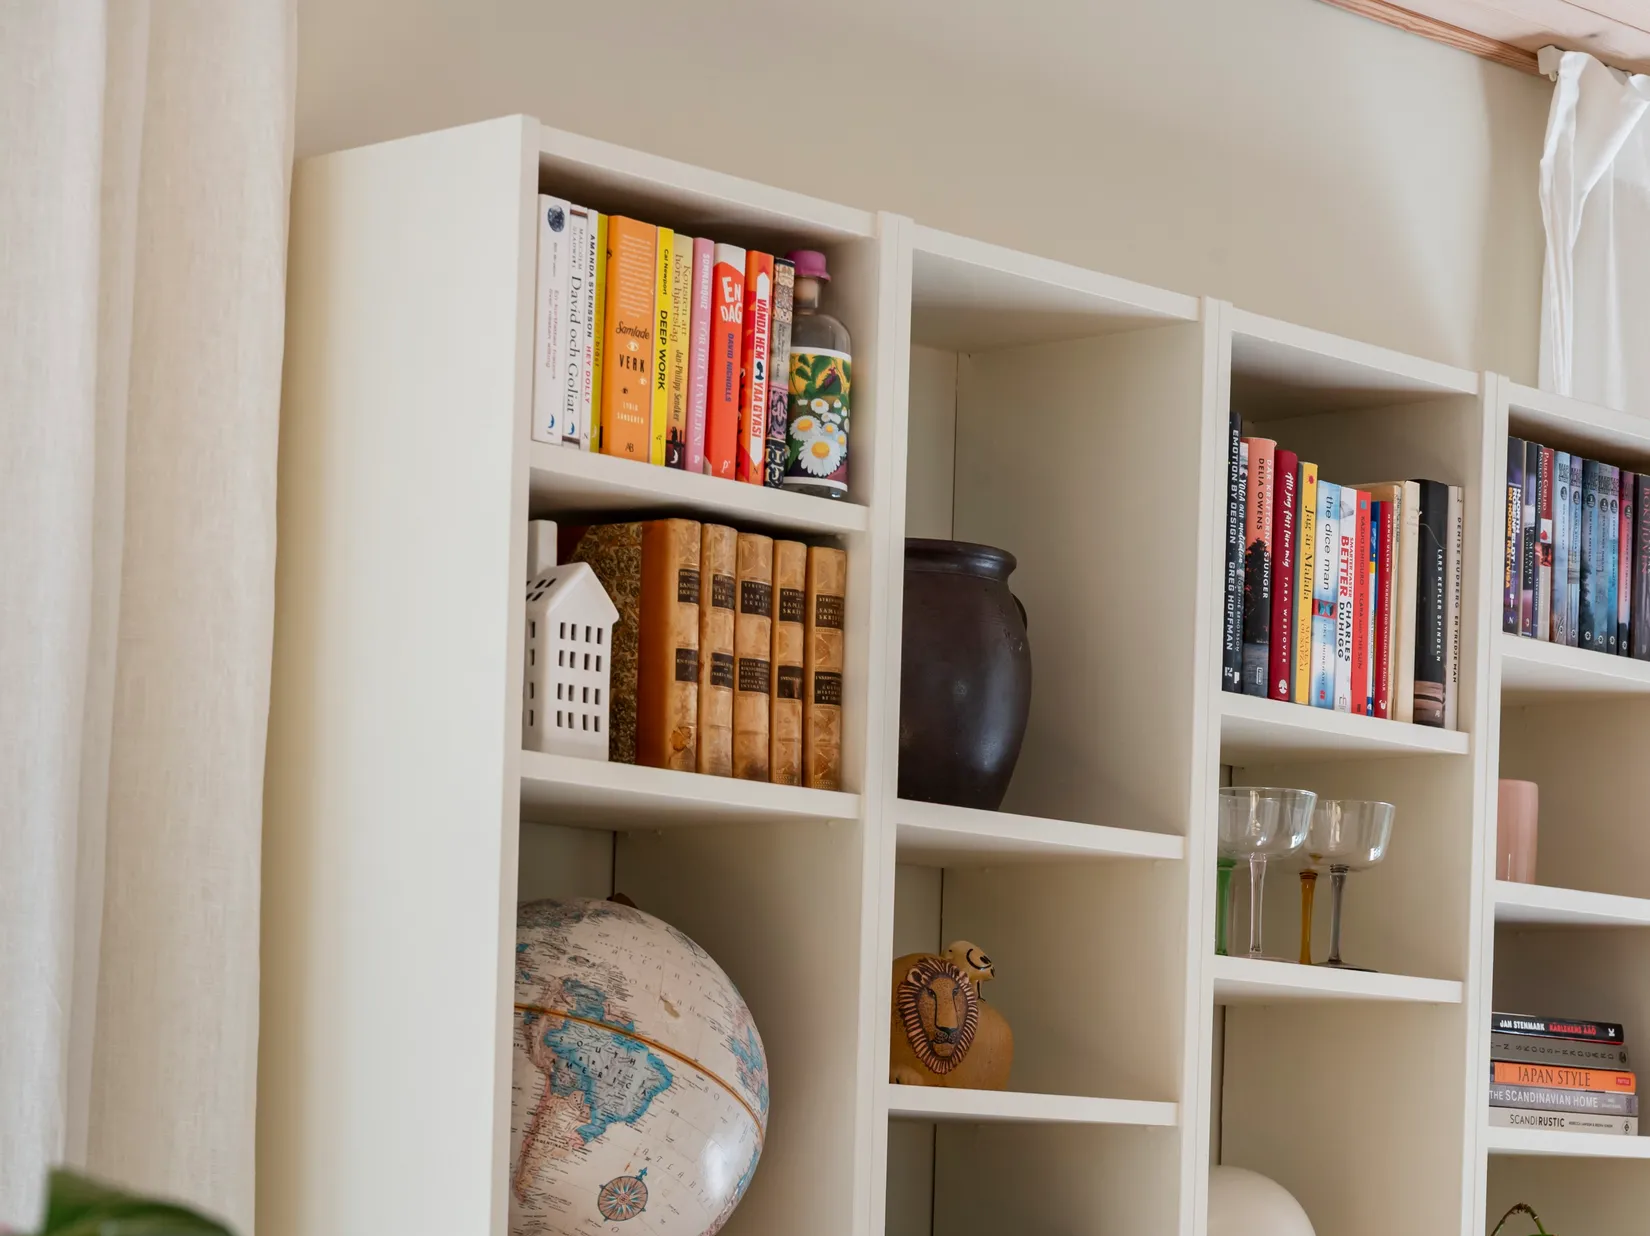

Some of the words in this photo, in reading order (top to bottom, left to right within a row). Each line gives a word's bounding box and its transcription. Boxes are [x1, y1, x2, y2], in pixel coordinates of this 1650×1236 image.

[682, 265, 691, 316] Konsten
[700, 253, 710, 309] SOMMARQUIZ
[721, 276, 742, 303] EN
[570, 275, 582, 325] David
[586, 281, 595, 338] SVENSSON
[720, 302, 743, 325] DAG
[755, 298, 767, 334] VÄNDA
[569, 328, 581, 358] och
[615, 320, 650, 340] Samlade
[660, 309, 668, 346] DEEP
[727, 332, 735, 359] DAVID
[755, 335, 766, 361] HEM
[619, 353, 645, 373] VERK
[657, 349, 667, 391] WORK
[672, 349, 684, 392] Jan-Philipp
[566, 362, 579, 414] Goliat
[584, 370, 592, 404] DOLLY
[725, 361, 733, 402] NICHOLLS
[753, 382, 764, 402] YAA
[673, 392, 682, 421] Sendker
[751, 404, 763, 438] GYASI
[1231, 429, 1239, 481] EMOTION
[1230, 485, 1238, 499] BY
[1238, 479, 1247, 502] YOGA
[1508, 487, 1514, 500] EN
[1229, 502, 1238, 544] DESIGN
[1304, 505, 1315, 530] Jag
[1325, 496, 1334, 519] the
[1323, 523, 1333, 554] dice
[1228, 561, 1236, 591] GREG
[1262, 552, 1270, 599] SJUNGER
[1303, 551, 1313, 600] Malala
[1323, 558, 1331, 591] man
[1339, 535, 1350, 597] BETTER
[1226, 595, 1235, 650] HOFFMAN
[1337, 602, 1345, 659] DUHIGG
[1344, 601, 1352, 662] CHARLES
[1499, 1020, 1513, 1028] JAN
[1513, 1020, 1545, 1031] STENMARK
[1518, 1066, 1553, 1084] JAPAN
[1557, 1069, 1591, 1087] STYLE
[1489, 1090, 1504, 1100] THE
[1505, 1089, 1571, 1106] SCANDINAVIAN
[1573, 1095, 1599, 1108] HOME
[1510, 1114, 1565, 1128] SCANDIRUSTIC
